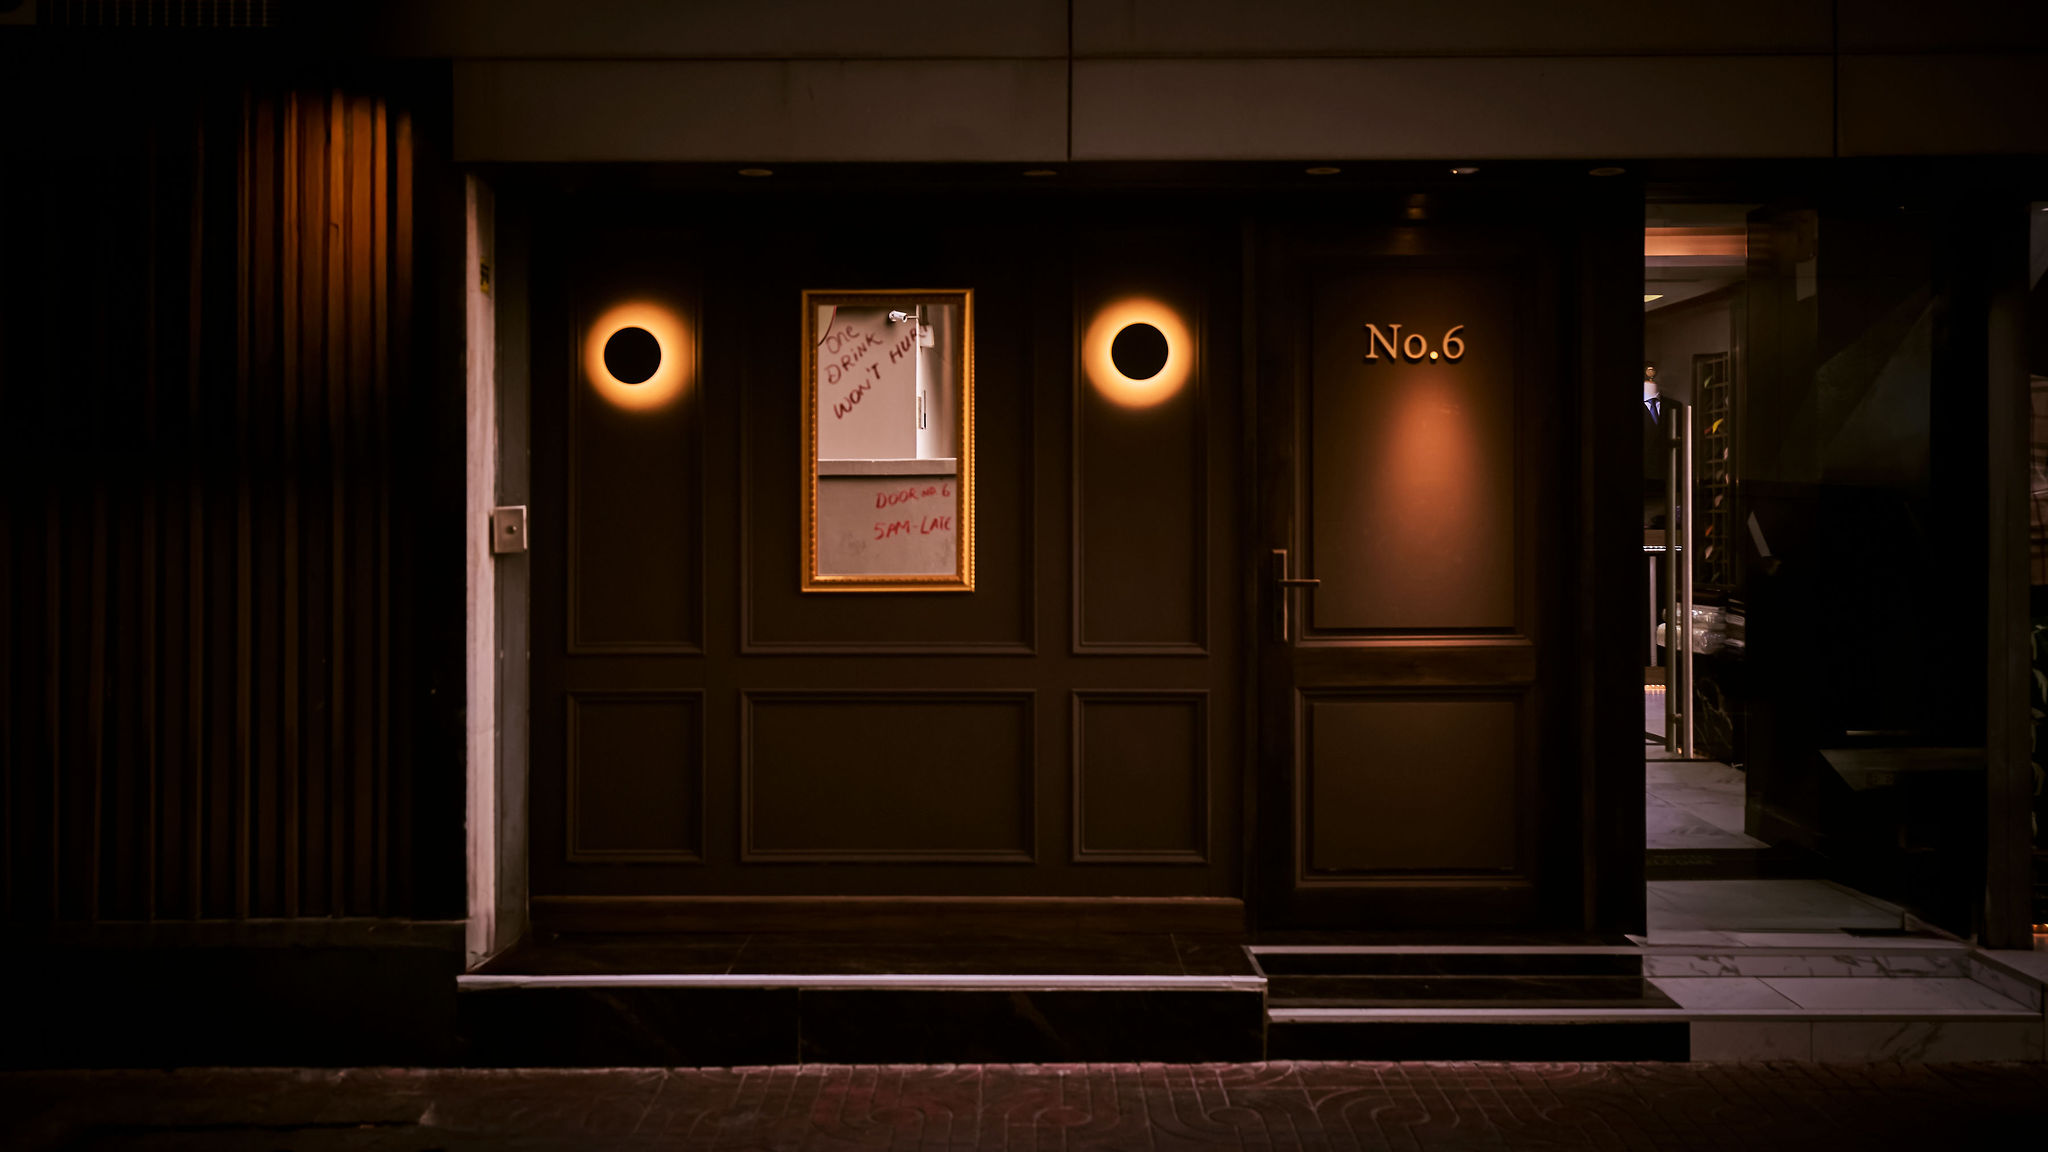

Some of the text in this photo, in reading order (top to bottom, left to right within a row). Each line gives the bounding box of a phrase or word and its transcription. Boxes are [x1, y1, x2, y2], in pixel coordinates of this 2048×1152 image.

[1365, 323, 1465, 360] No.6
[833, 363, 881, 419] WON'T
[875, 487, 918, 509] DOOR
[941, 483, 951, 498] 6
